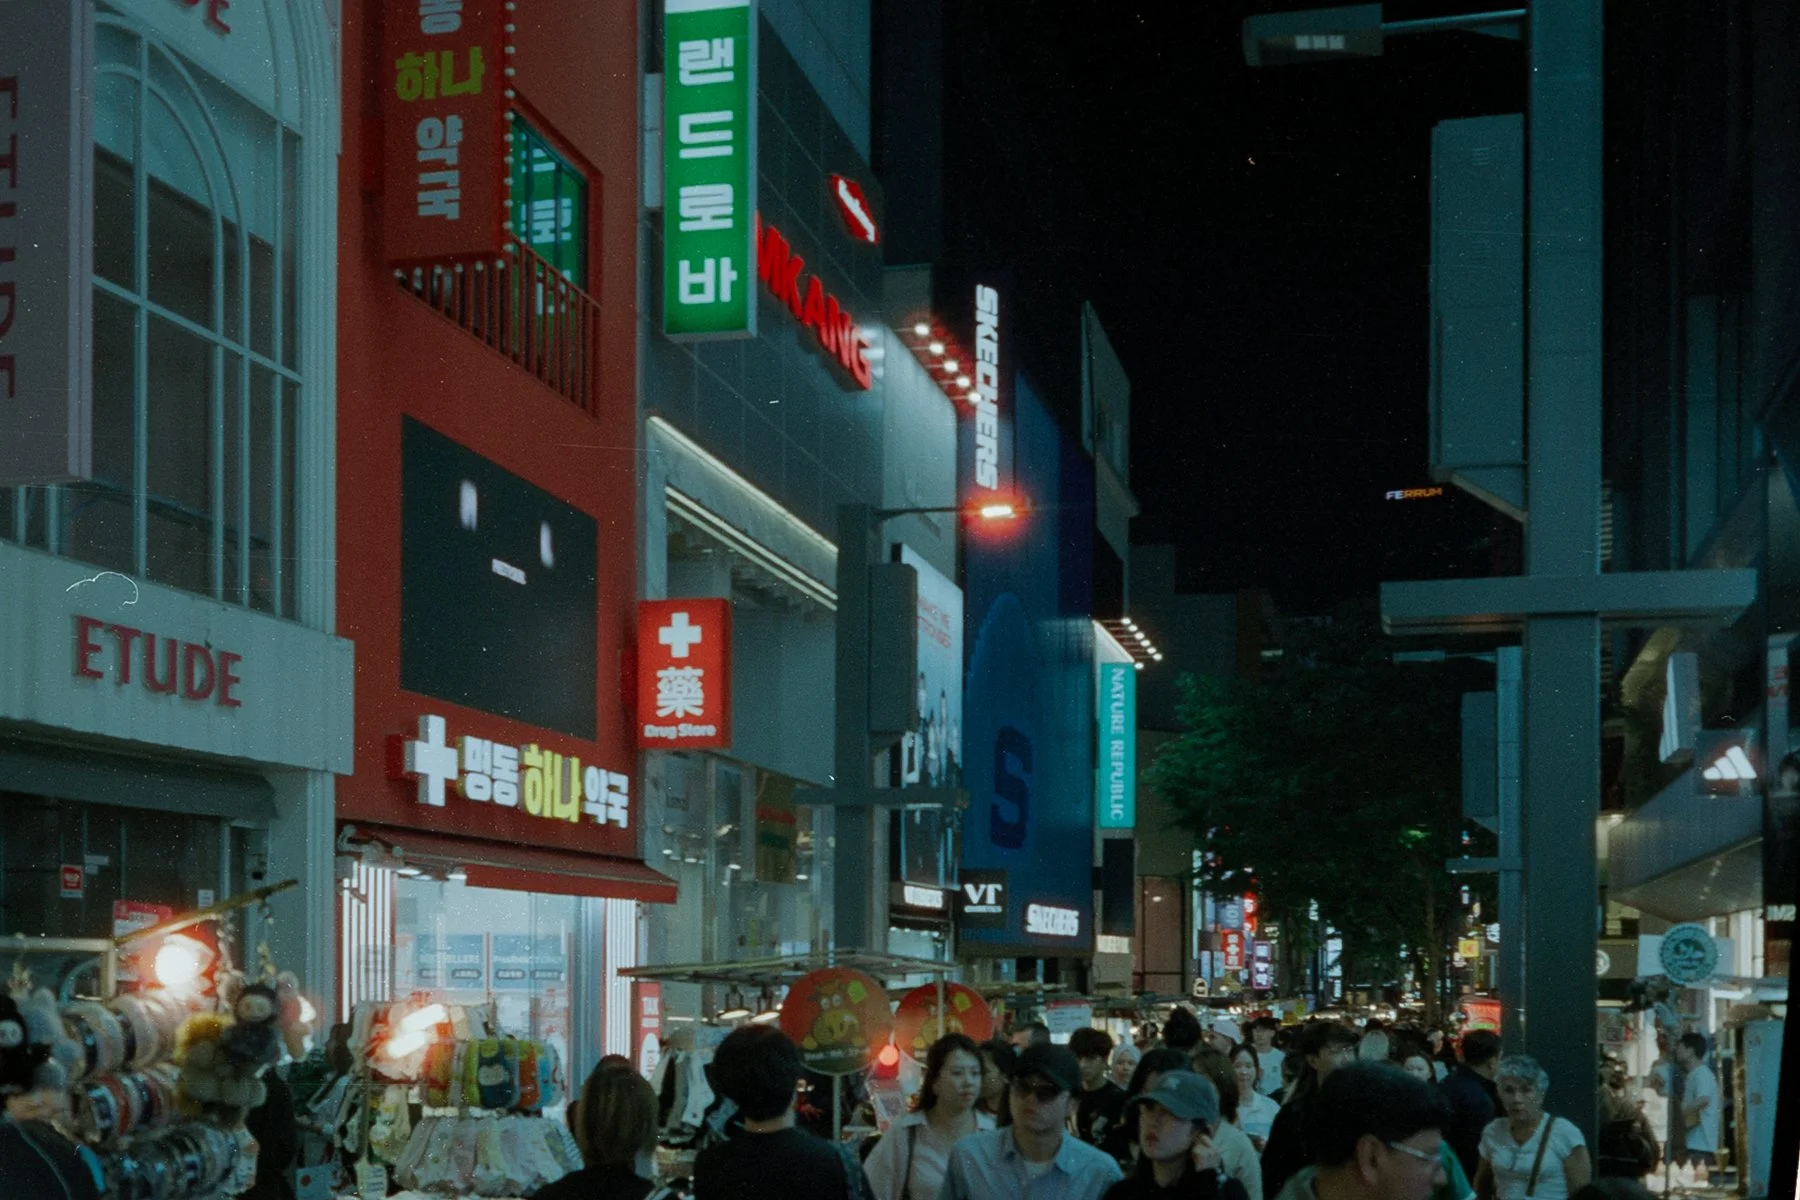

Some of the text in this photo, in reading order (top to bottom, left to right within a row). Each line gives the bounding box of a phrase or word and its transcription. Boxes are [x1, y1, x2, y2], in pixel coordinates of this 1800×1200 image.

[975, 283, 1000, 491] SKECHERS
[74, 615, 243, 708] ETUDE
[656, 666, 705, 718] 藥
[679, 723, 717, 738] Store
[1109, 667, 1126, 821] NATURE REPUBLIC
[964, 883, 1003, 905] VT
